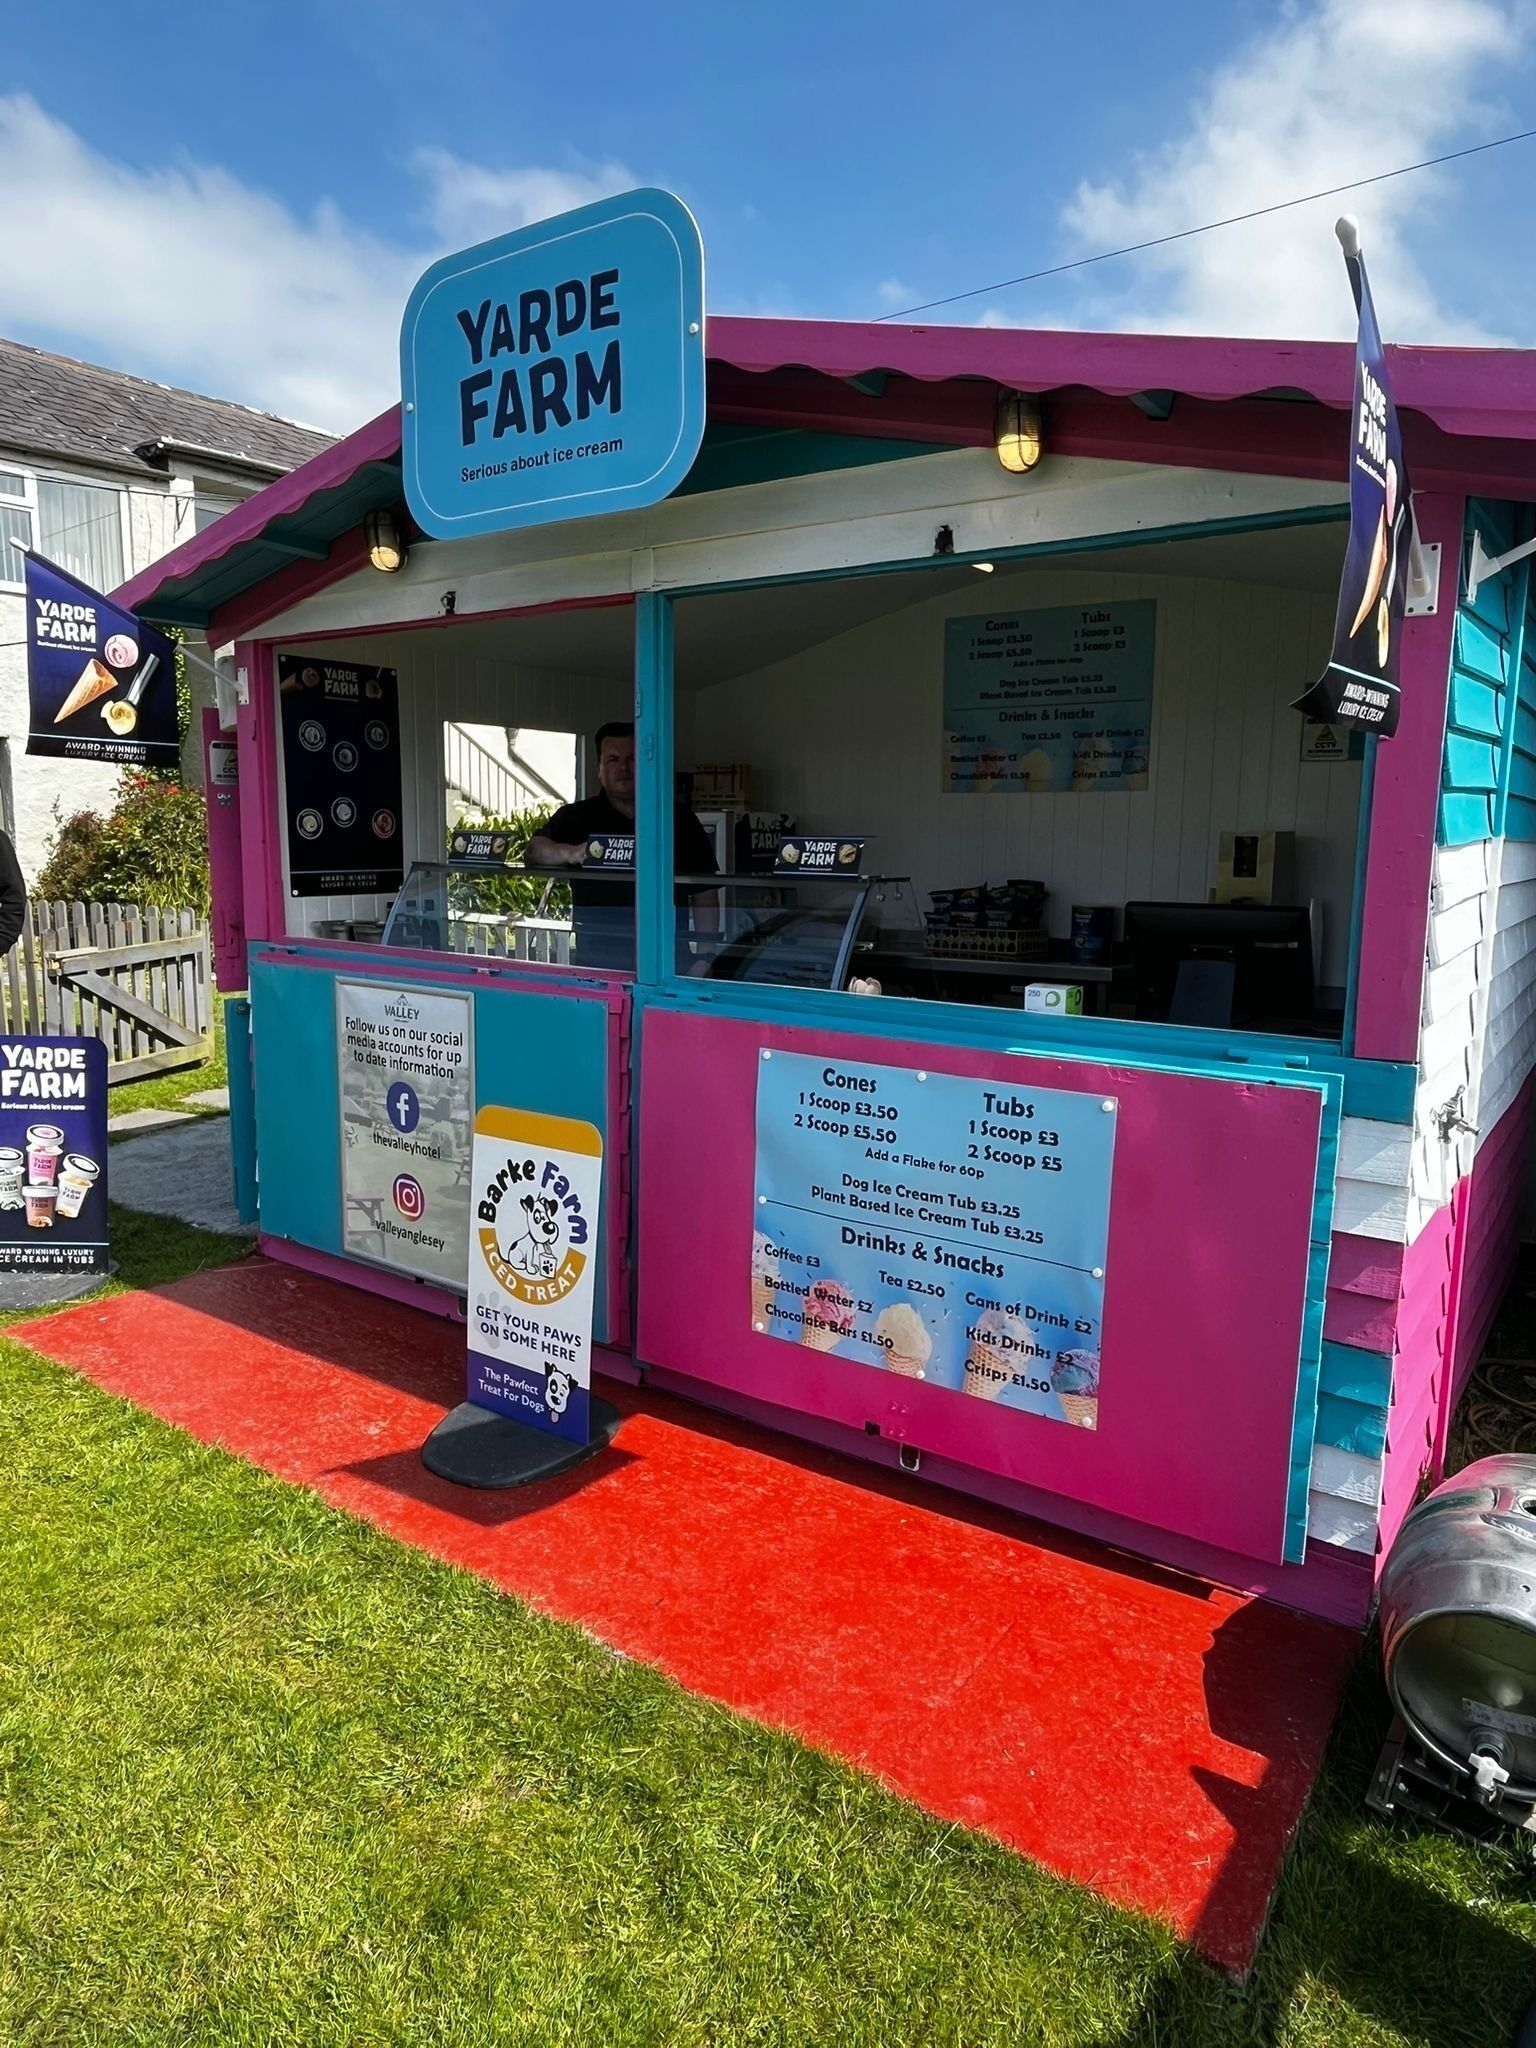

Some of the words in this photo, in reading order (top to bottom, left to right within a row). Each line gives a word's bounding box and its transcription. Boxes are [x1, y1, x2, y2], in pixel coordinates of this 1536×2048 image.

[457, 269, 620, 364] YARDE
[460, 340, 621, 446] FARM
[1358, 401, 1386, 469] FARM
[461, 459, 508, 482] Serious
[511, 452, 550, 471] about
[553, 448, 573, 462] ice
[577, 439, 623, 457] cream
[36, 599, 95, 622] YARDE
[1081, 610, 1111, 624] Tubs
[36, 617, 96, 643] FARM
[986, 620, 1019, 631] Cones
[1081, 628, 1110, 637] Scoop
[977, 651, 1003, 660] Scoop
[978, 637, 1003, 647] Scoop
[1083, 642, 1111, 651] Scoop
[324, 667, 358, 682] YARDE
[324, 679, 359, 696] FARM
[999, 710, 1036, 722] Drinks
[1041, 710, 1050, 720] &
[1054, 707, 1095, 720] Snacks
[65, 742, 146, 754] AWARD-WINNING
[466, 844, 491, 854] FARM
[471, 834, 493, 843] YARDE
[608, 838, 634, 849] YARDE
[805, 841, 837, 852] YARDE
[605, 848, 633, 860] FARM
[800, 852, 835, 865] FARM
[384, 1005, 420, 1020] VALLEY
[346, 1017, 376, 1033] Follow
[379, 1025, 390, 1036] us
[393, 1027, 406, 1038] on
[409, 1029, 427, 1041] our
[430, 1032, 463, 1046] social
[1, 1044, 86, 1071] YARDE
[348, 1034, 376, 1049] media
[379, 1041, 424, 1057] accounts
[427, 1045, 443, 1060] for
[447, 1051, 462, 1066] up
[354, 1050, 364, 1062] to
[366, 1051, 387, 1067] date
[390, 1056, 454, 1079] information
[1, 1069, 86, 1099] FARM
[823, 1068, 877, 1093] Cones
[800, 1092, 804, 1104] 1
[809, 1092, 850, 1115] Scoop
[855, 1102, 898, 1120] £3.50
[983, 1093, 1034, 1118] Tubs
[794, 1114, 803, 1127] 2
[807, 1114, 849, 1137] Scoop
[854, 1125, 897, 1143] £5.50
[969, 1120, 975, 1134] 1
[981, 1120, 1032, 1145] Scoop
[1038, 1131, 1059, 1146] £3
[373, 1132, 441, 1159] thevalleyhotel
[968, 1144, 978, 1159] 2
[984, 1145, 1036, 1170] Scoop
[1042, 1156, 1062, 1171] £5
[865, 1148, 888, 1162] Add
[892, 1155, 899, 1163] a
[903, 1154, 935, 1170] Flake
[939, 1160, 956, 1174] for
[959, 1166, 984, 1179] 60p
[478, 1159, 536, 1223] Barke
[541, 1161, 588, 1244] Farm
[842, 1174, 869, 1192] Dog
[873, 1180, 892, 1195] Ice
[896, 1184, 943, 1204] Cream
[948, 1194, 976, 1211] Tub
[981, 1201, 1020, 1219] £3.25
[812, 1185, 846, 1204] Plant
[849, 1194, 890, 1214] Based
[895, 1203, 913, 1218] Ice
[918, 1208, 966, 1229] Cream
[971, 1217, 1000, 1235] Tub
[1004, 1226, 1044, 1244] £3.25
[376, 1220, 445, 1251] valleyanglesey
[15, 1255, 49, 1263] CREAM
[764, 1244, 803, 1263] Coffee
[806, 1255, 820, 1268] £3
[842, 1226, 906, 1256] Drinks
[912, 1241, 927, 1261] &
[933, 1246, 1004, 1278] Snacks
[484, 1242, 517, 1290] ICED
[524, 1263, 576, 1301] TREAT
[879, 1270, 903, 1288] Tea
[907, 1279, 945, 1298] £2.50
[765, 1276, 810, 1297] Bottled
[814, 1288, 854, 1308] Water
[858, 1301, 873, 1314] £2
[476, 1305, 500, 1321] GET
[504, 1313, 539, 1334] YOUR
[544, 1326, 582, 1347] PAWS
[765, 1303, 826, 1330] Chocolate
[830, 1321, 857, 1338] Bars
[861, 1331, 894, 1348] £1.50
[965, 1292, 1001, 1311] Cans
[1006, 1303, 1021, 1316] of
[1025, 1306, 1070, 1328] Drink
[1074, 1319, 1092, 1335] £2
[480, 1322, 499, 1337] ON
[503, 1329, 537, 1350] SOME
[542, 1341, 576, 1362] HERE
[966, 1326, 996, 1345] Kids
[1002, 1335, 1051, 1359] Drinks
[1056, 1352, 1074, 1366] £2
[484, 1367, 501, 1381] The
[504, 1374, 538, 1395] Pawfect
[964, 1359, 1007, 1382] Crisps
[1012, 1373, 1050, 1393] £1.50
[478, 1379, 501, 1397] Treat
[504, 1388, 519, 1402] For
[521, 1395, 545, 1413] Dogs
